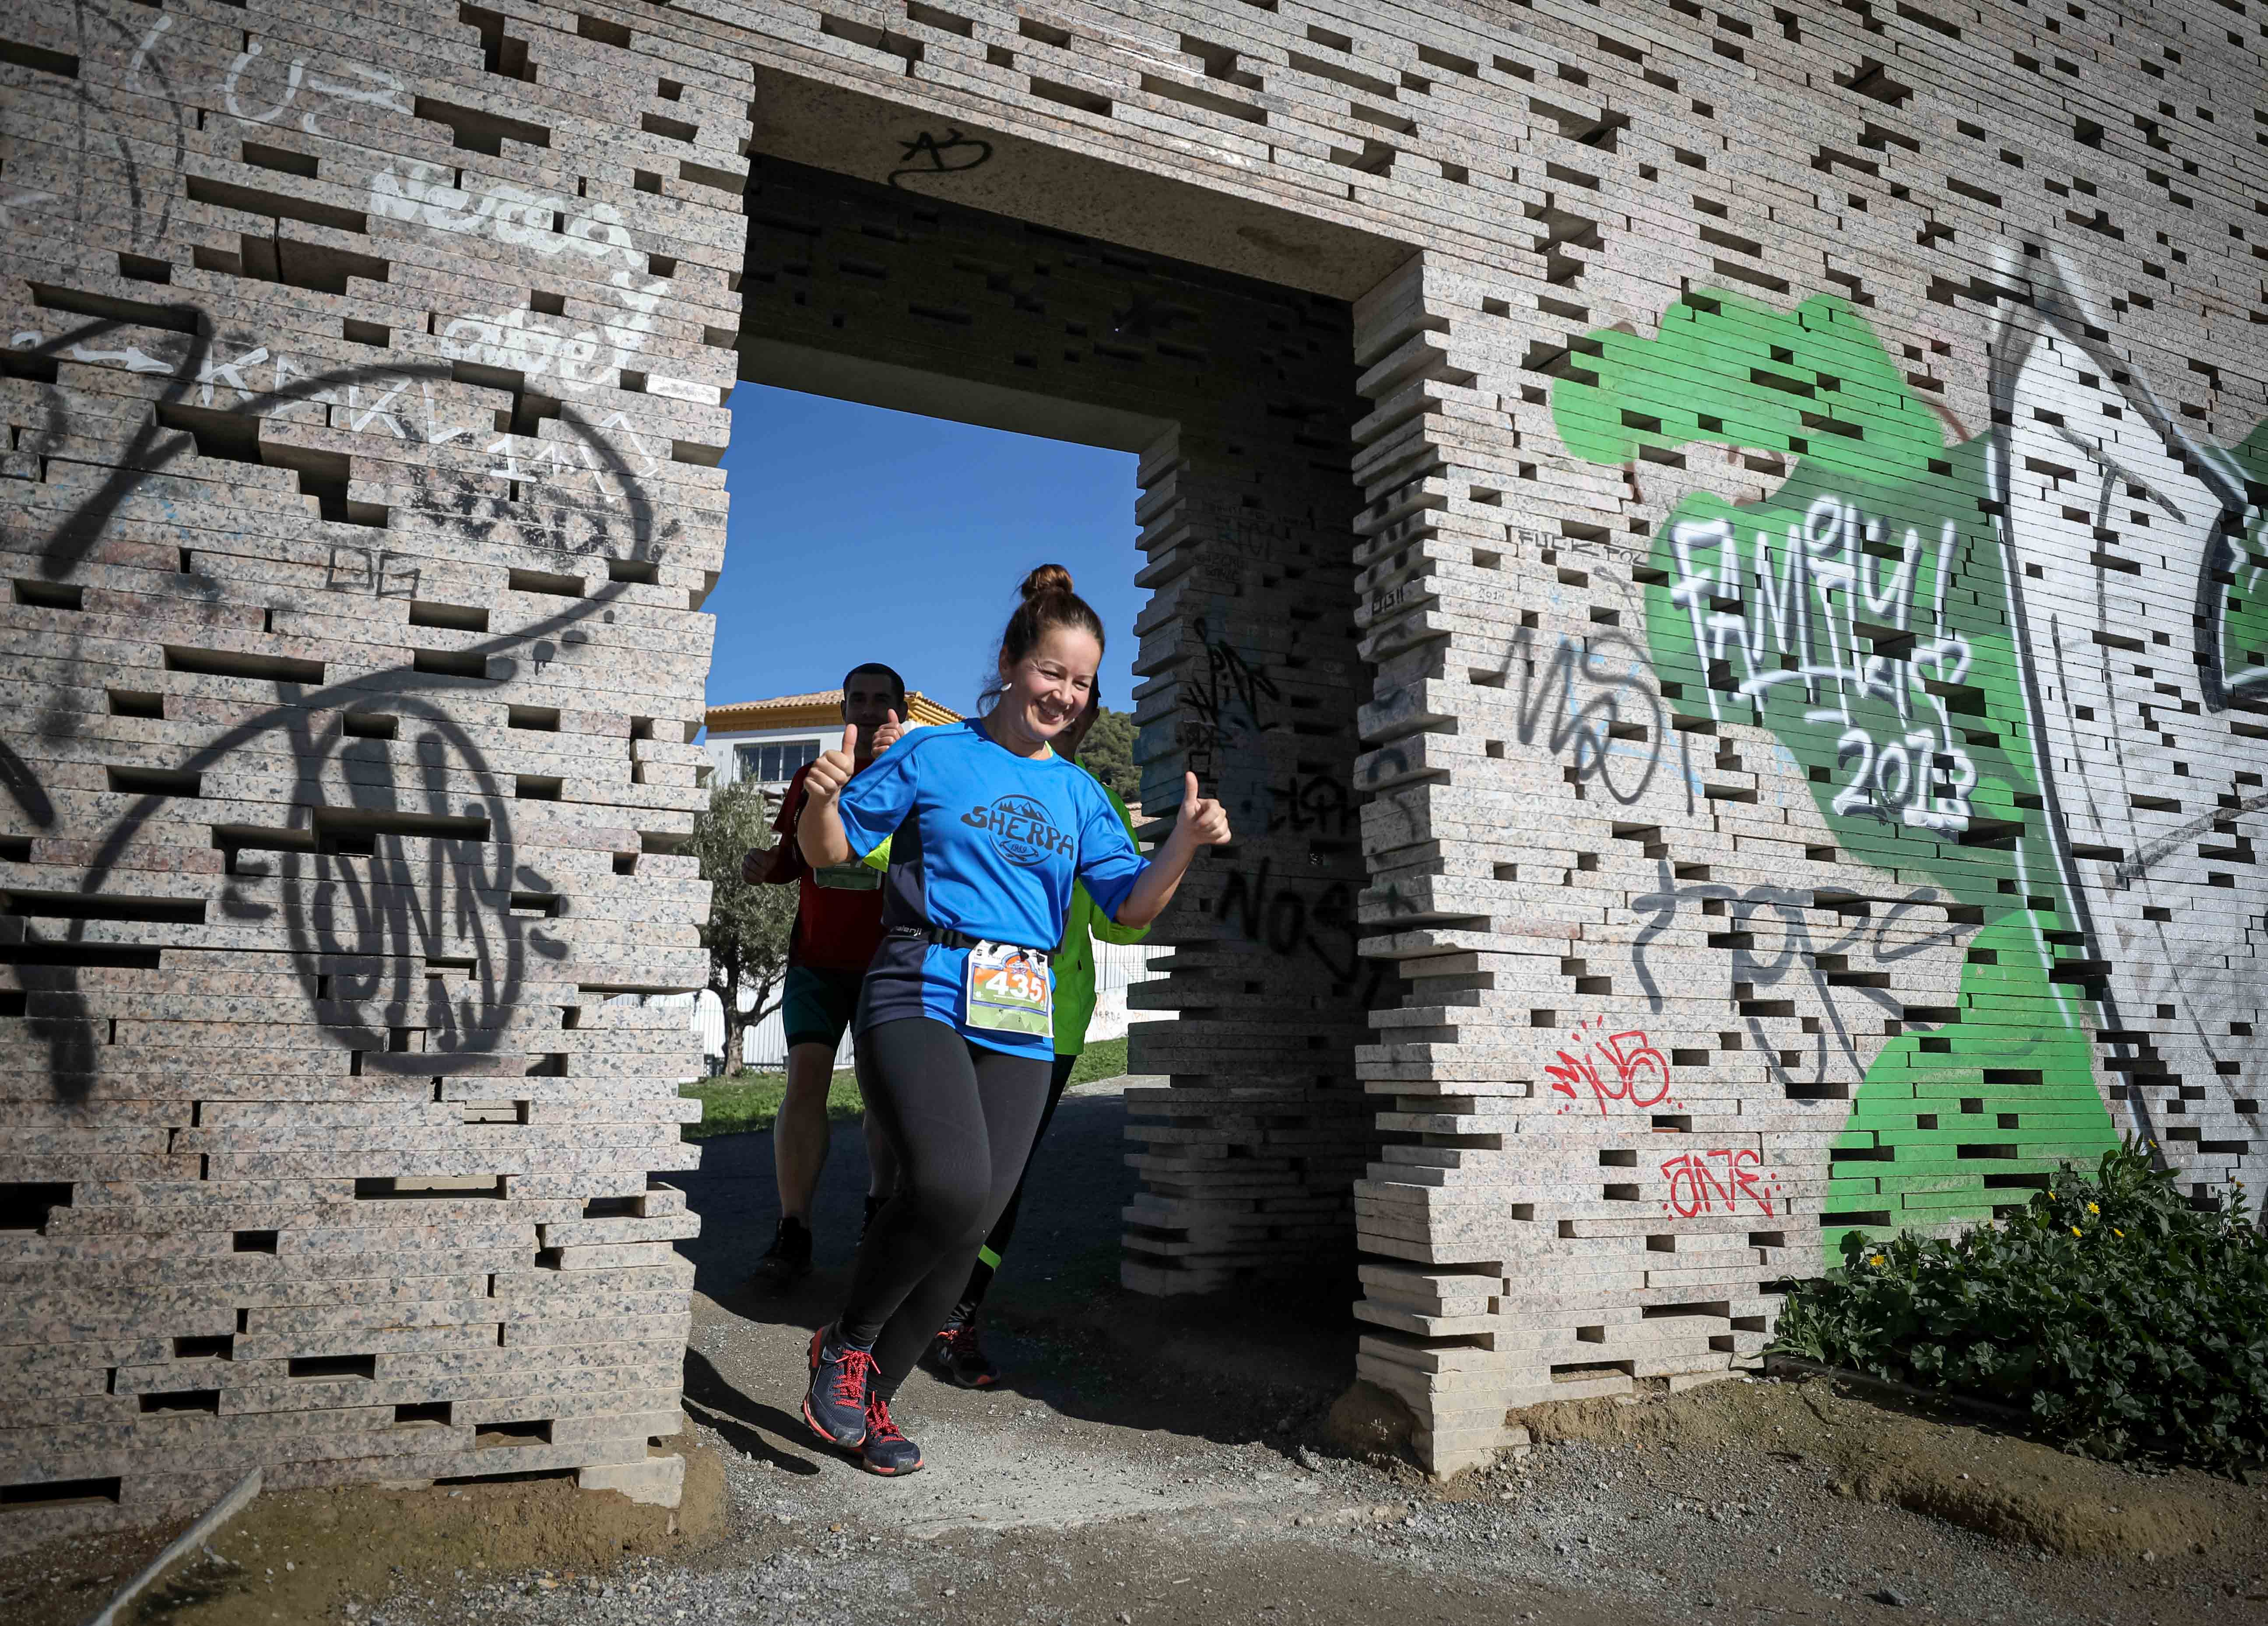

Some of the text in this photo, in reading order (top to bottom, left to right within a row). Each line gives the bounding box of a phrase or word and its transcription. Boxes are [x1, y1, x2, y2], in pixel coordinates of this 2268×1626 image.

[1518, 529, 1600, 557] FUCK
[960, 805, 1074, 861] SHERPA
[985, 971, 1043, 1002] 435
